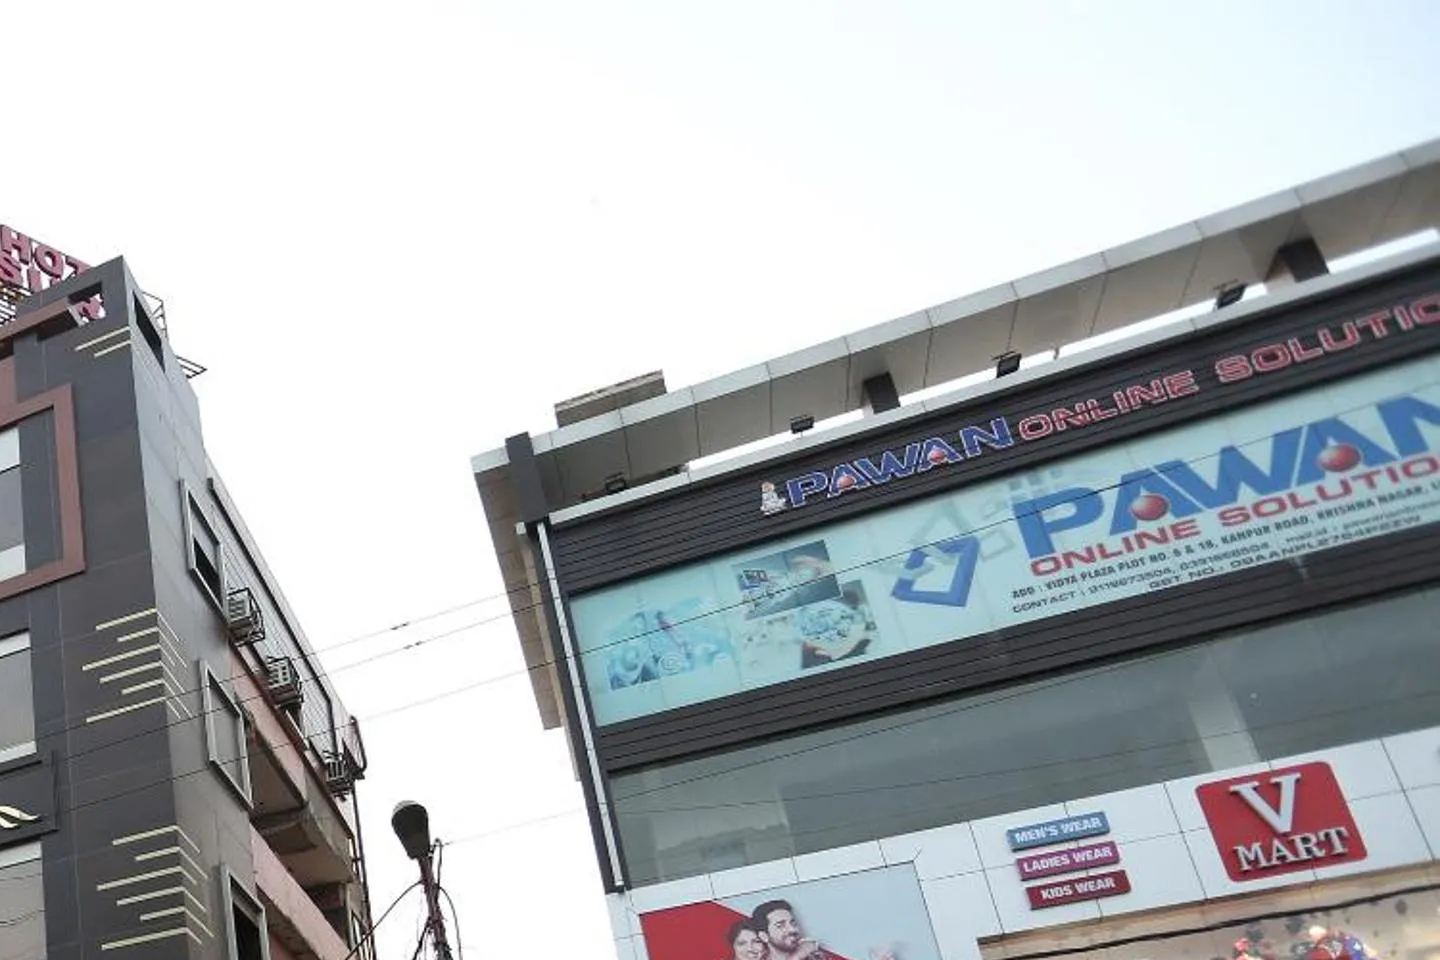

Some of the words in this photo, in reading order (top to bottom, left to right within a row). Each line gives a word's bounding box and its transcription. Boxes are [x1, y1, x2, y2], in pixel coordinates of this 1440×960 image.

[787, 416, 1014, 508] PAWAN
[1017, 369, 1200, 442] ONLINE
[1030, 518, 1201, 577] ONLINE
[1229, 772, 1302, 835] V
[1014, 825, 1059, 844] MEN'S
[1060, 817, 1102, 834] WEAR
[1231, 825, 1349, 873] MART
[1022, 853, 1071, 873] LADIES
[1072, 846, 1113, 864] WEAR
[1040, 884, 1073, 901] KIDS
[1074, 877, 1116, 895] WEAR
